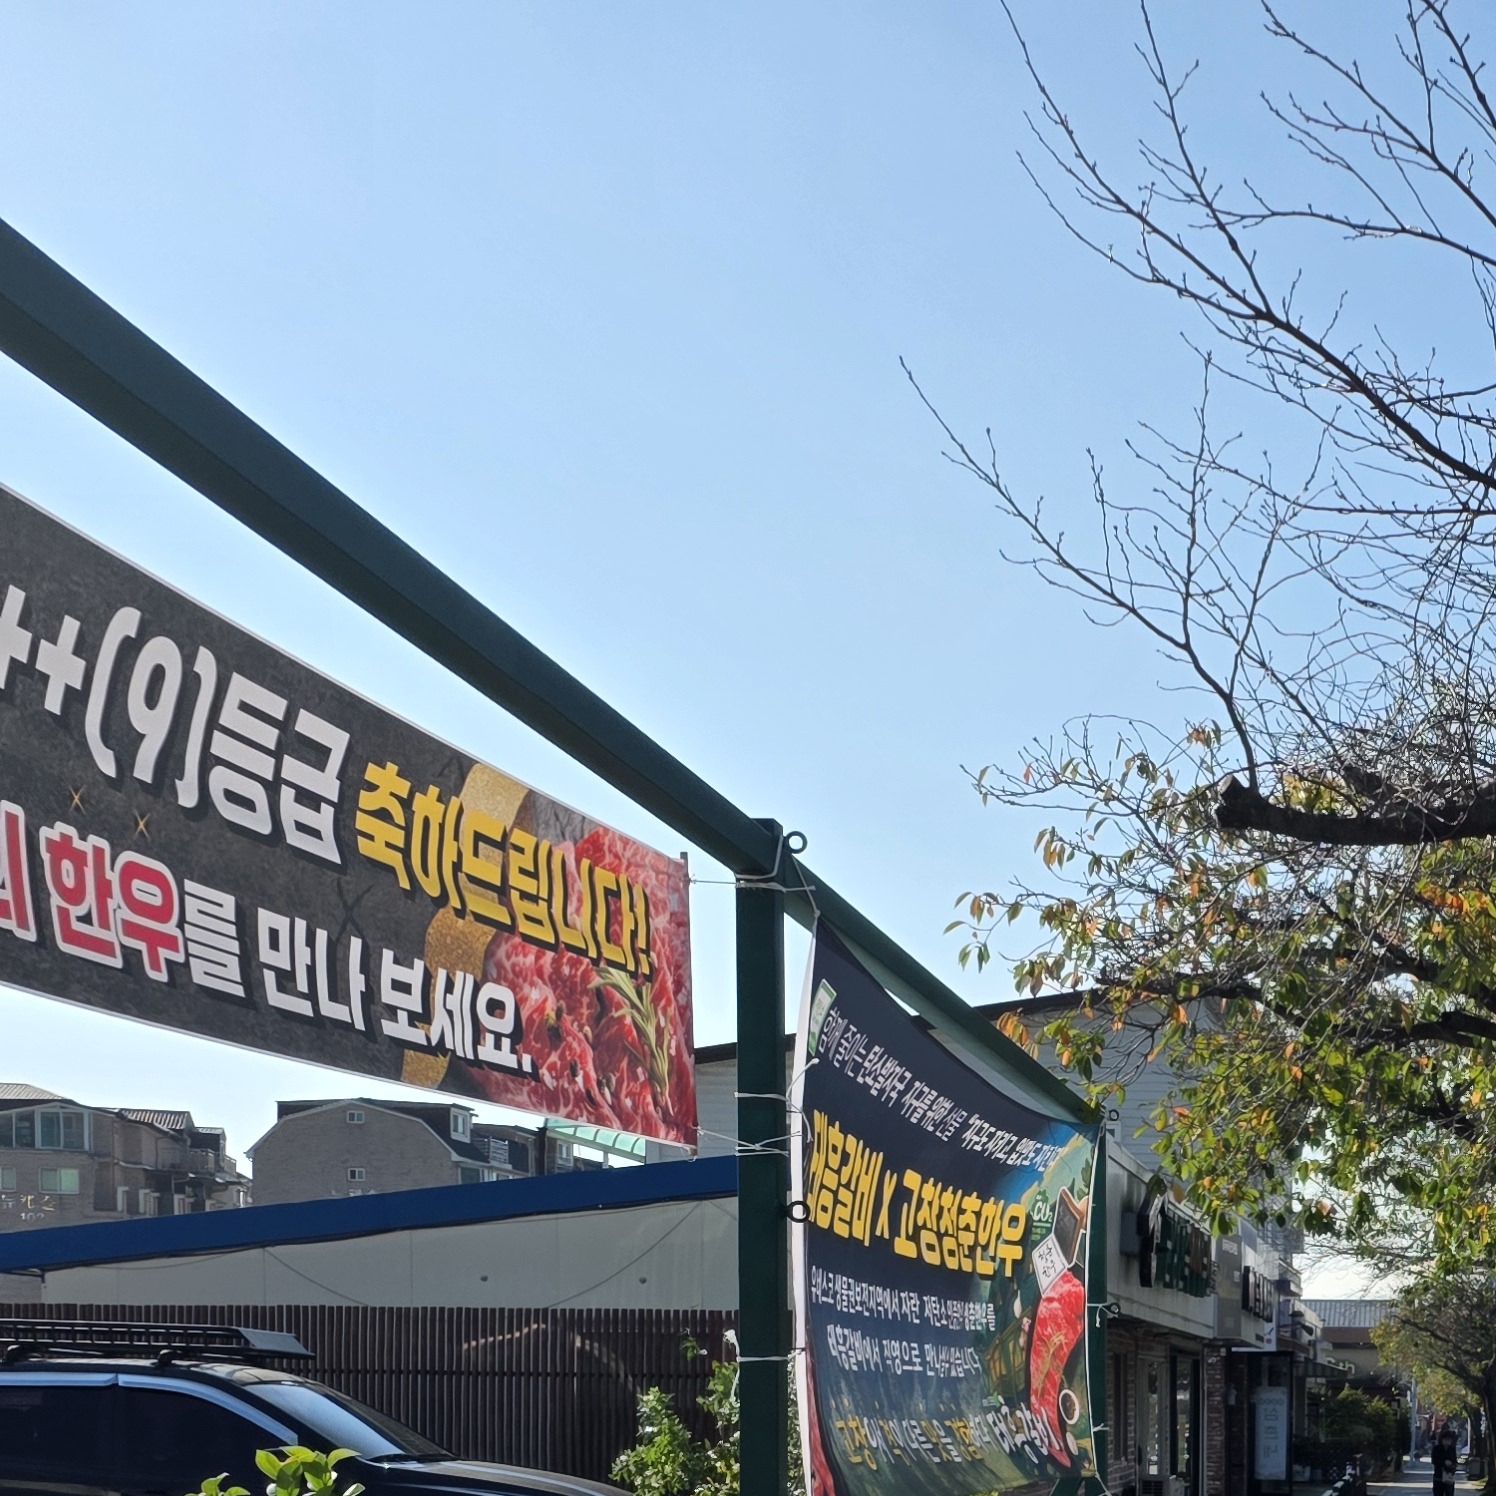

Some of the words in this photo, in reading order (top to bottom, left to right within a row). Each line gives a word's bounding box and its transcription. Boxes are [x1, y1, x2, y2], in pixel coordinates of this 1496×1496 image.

[40, 821, 246, 999] 한우를
[257, 906, 366, 1031] 만나
[381, 948, 533, 1073] 보세요.
[355, 762, 650, 976] 축하드립니다!
[833, 1024, 869, 1078] 줄이는
[856, 1045, 912, 1107] 탄소발자국
[807, 1109, 884, 1247] 대흥갈비
[894, 1168, 1026, 1278] 고창청춘한우
